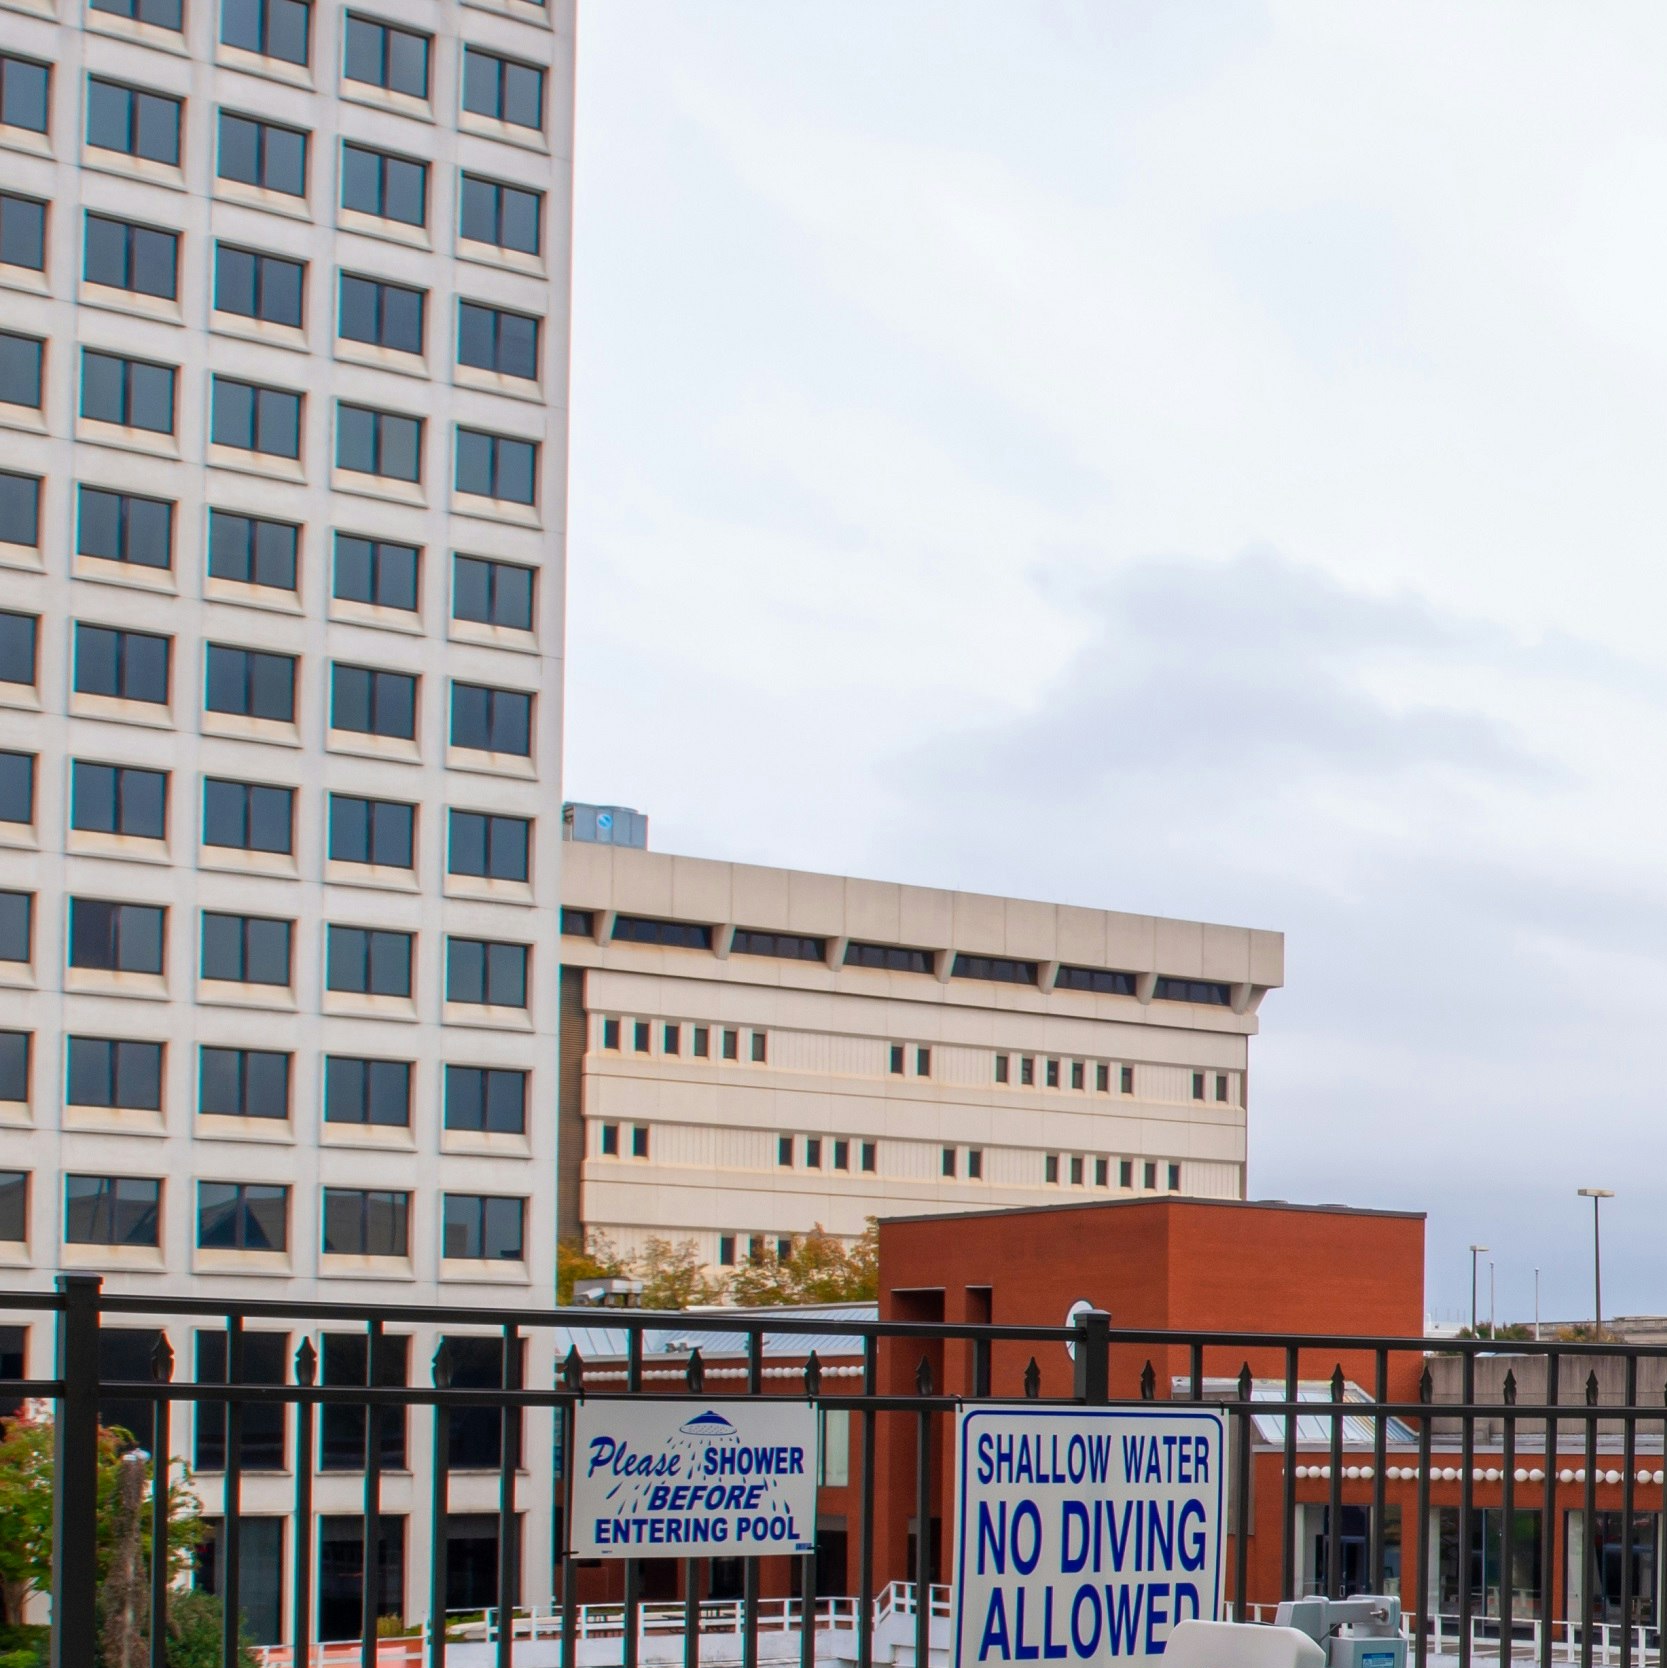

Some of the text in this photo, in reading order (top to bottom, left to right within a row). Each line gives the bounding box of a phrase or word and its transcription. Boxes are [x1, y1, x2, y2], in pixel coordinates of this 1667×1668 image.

[588, 1436, 804, 1478] Please SHOWER
[977, 1433, 1209, 1484] SHALLOW WATER
[647, 1484, 765, 1511] BEFORE
[595, 1516, 800, 1544] ENTERING POOL
[977, 1498, 1206, 1576] NO DIVING
